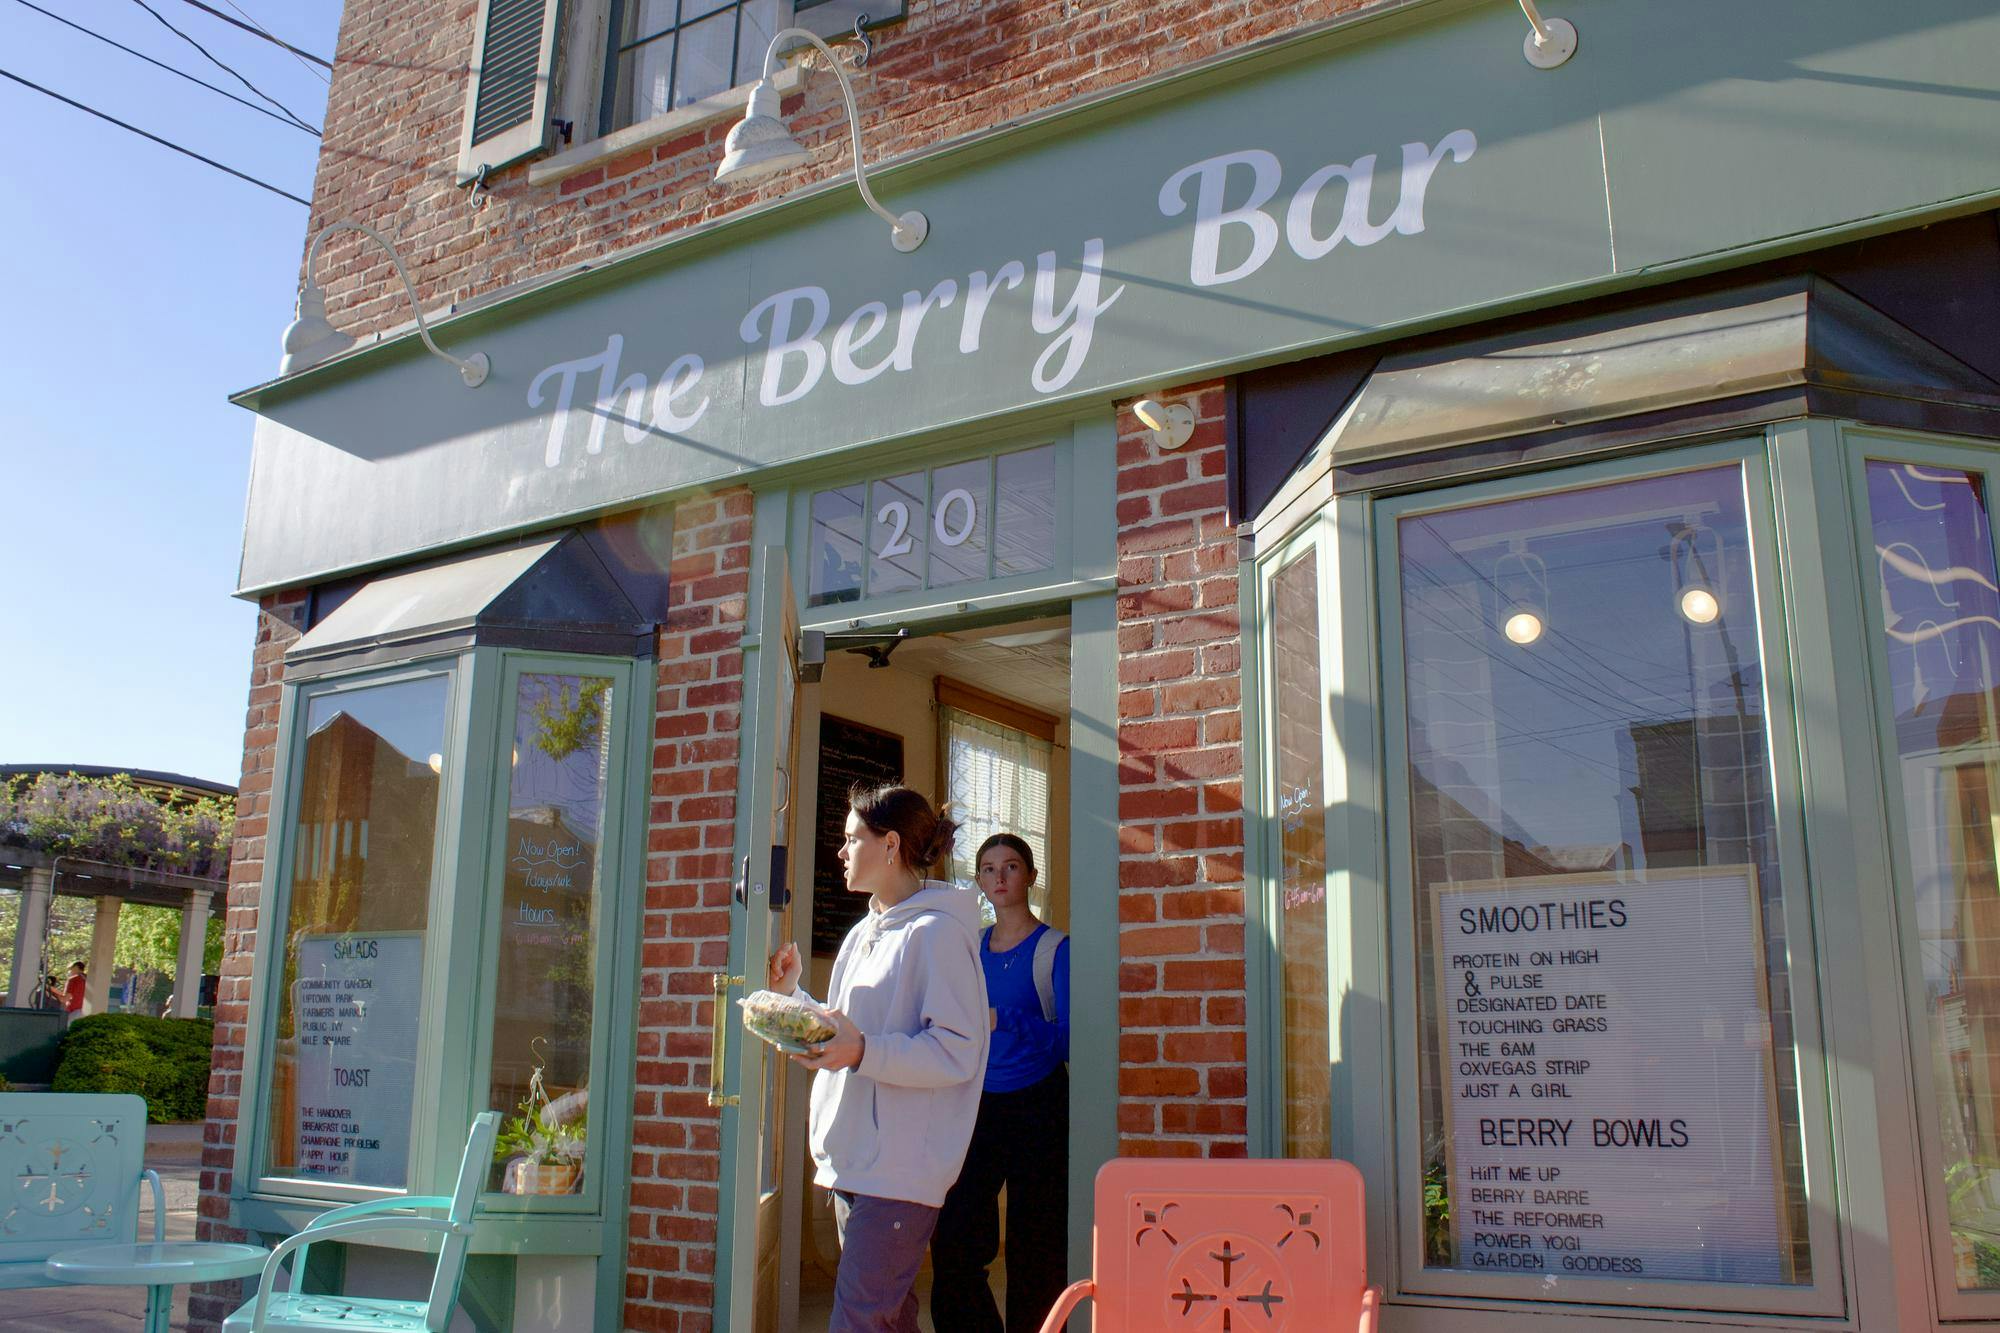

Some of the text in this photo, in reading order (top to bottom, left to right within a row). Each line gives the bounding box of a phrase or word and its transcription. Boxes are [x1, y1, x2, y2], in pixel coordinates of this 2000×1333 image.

[526, 128, 1478, 470] The Berry Bar
[877, 487, 977, 560] 20
[519, 836, 580, 861] Now Open!
[520, 900, 554, 923] Hours
[1460, 899, 1627, 935] SMOOTHIES
[334, 941, 378, 959] SALADS
[1453, 949, 1598, 969] PROTEIN ON HIGH
[1464, 970, 1543, 997] & PULSE
[302, 994, 354, 1002] UPTOWN PARK
[1457, 995, 1607, 1013] DESIGNATED DATE
[302, 1008, 335, 1017] FARMERS
[302, 1022, 343, 1031] PUBLIC IVY
[1459, 1017, 1607, 1034] TOUCHING GRASS
[302, 1036, 318, 1045] MILE
[1459, 1042, 1535, 1056] THE 6AM
[1460, 1060, 1590, 1075] OXVEGAS STRIP
[334, 1069, 370, 1086] TOAST
[1461, 1083, 1572, 1098] JUST A GIRL
[302, 1108, 313, 1117] THE
[302, 1121, 359, 1133] BREAKFAST CLUB
[1480, 1119, 1689, 1147] BERRY BOWLS
[1509, 1167, 1531, 1181] ME
[1538, 1168, 1561, 1181] UP
[1471, 1188, 1590, 1205] BERRY BARRE
[1472, 1211, 1604, 1229] THE REFORMER
[1474, 1233, 1580, 1251] POWER YOGI
[1473, 1253, 1643, 1273] GARDEN GODDESS
